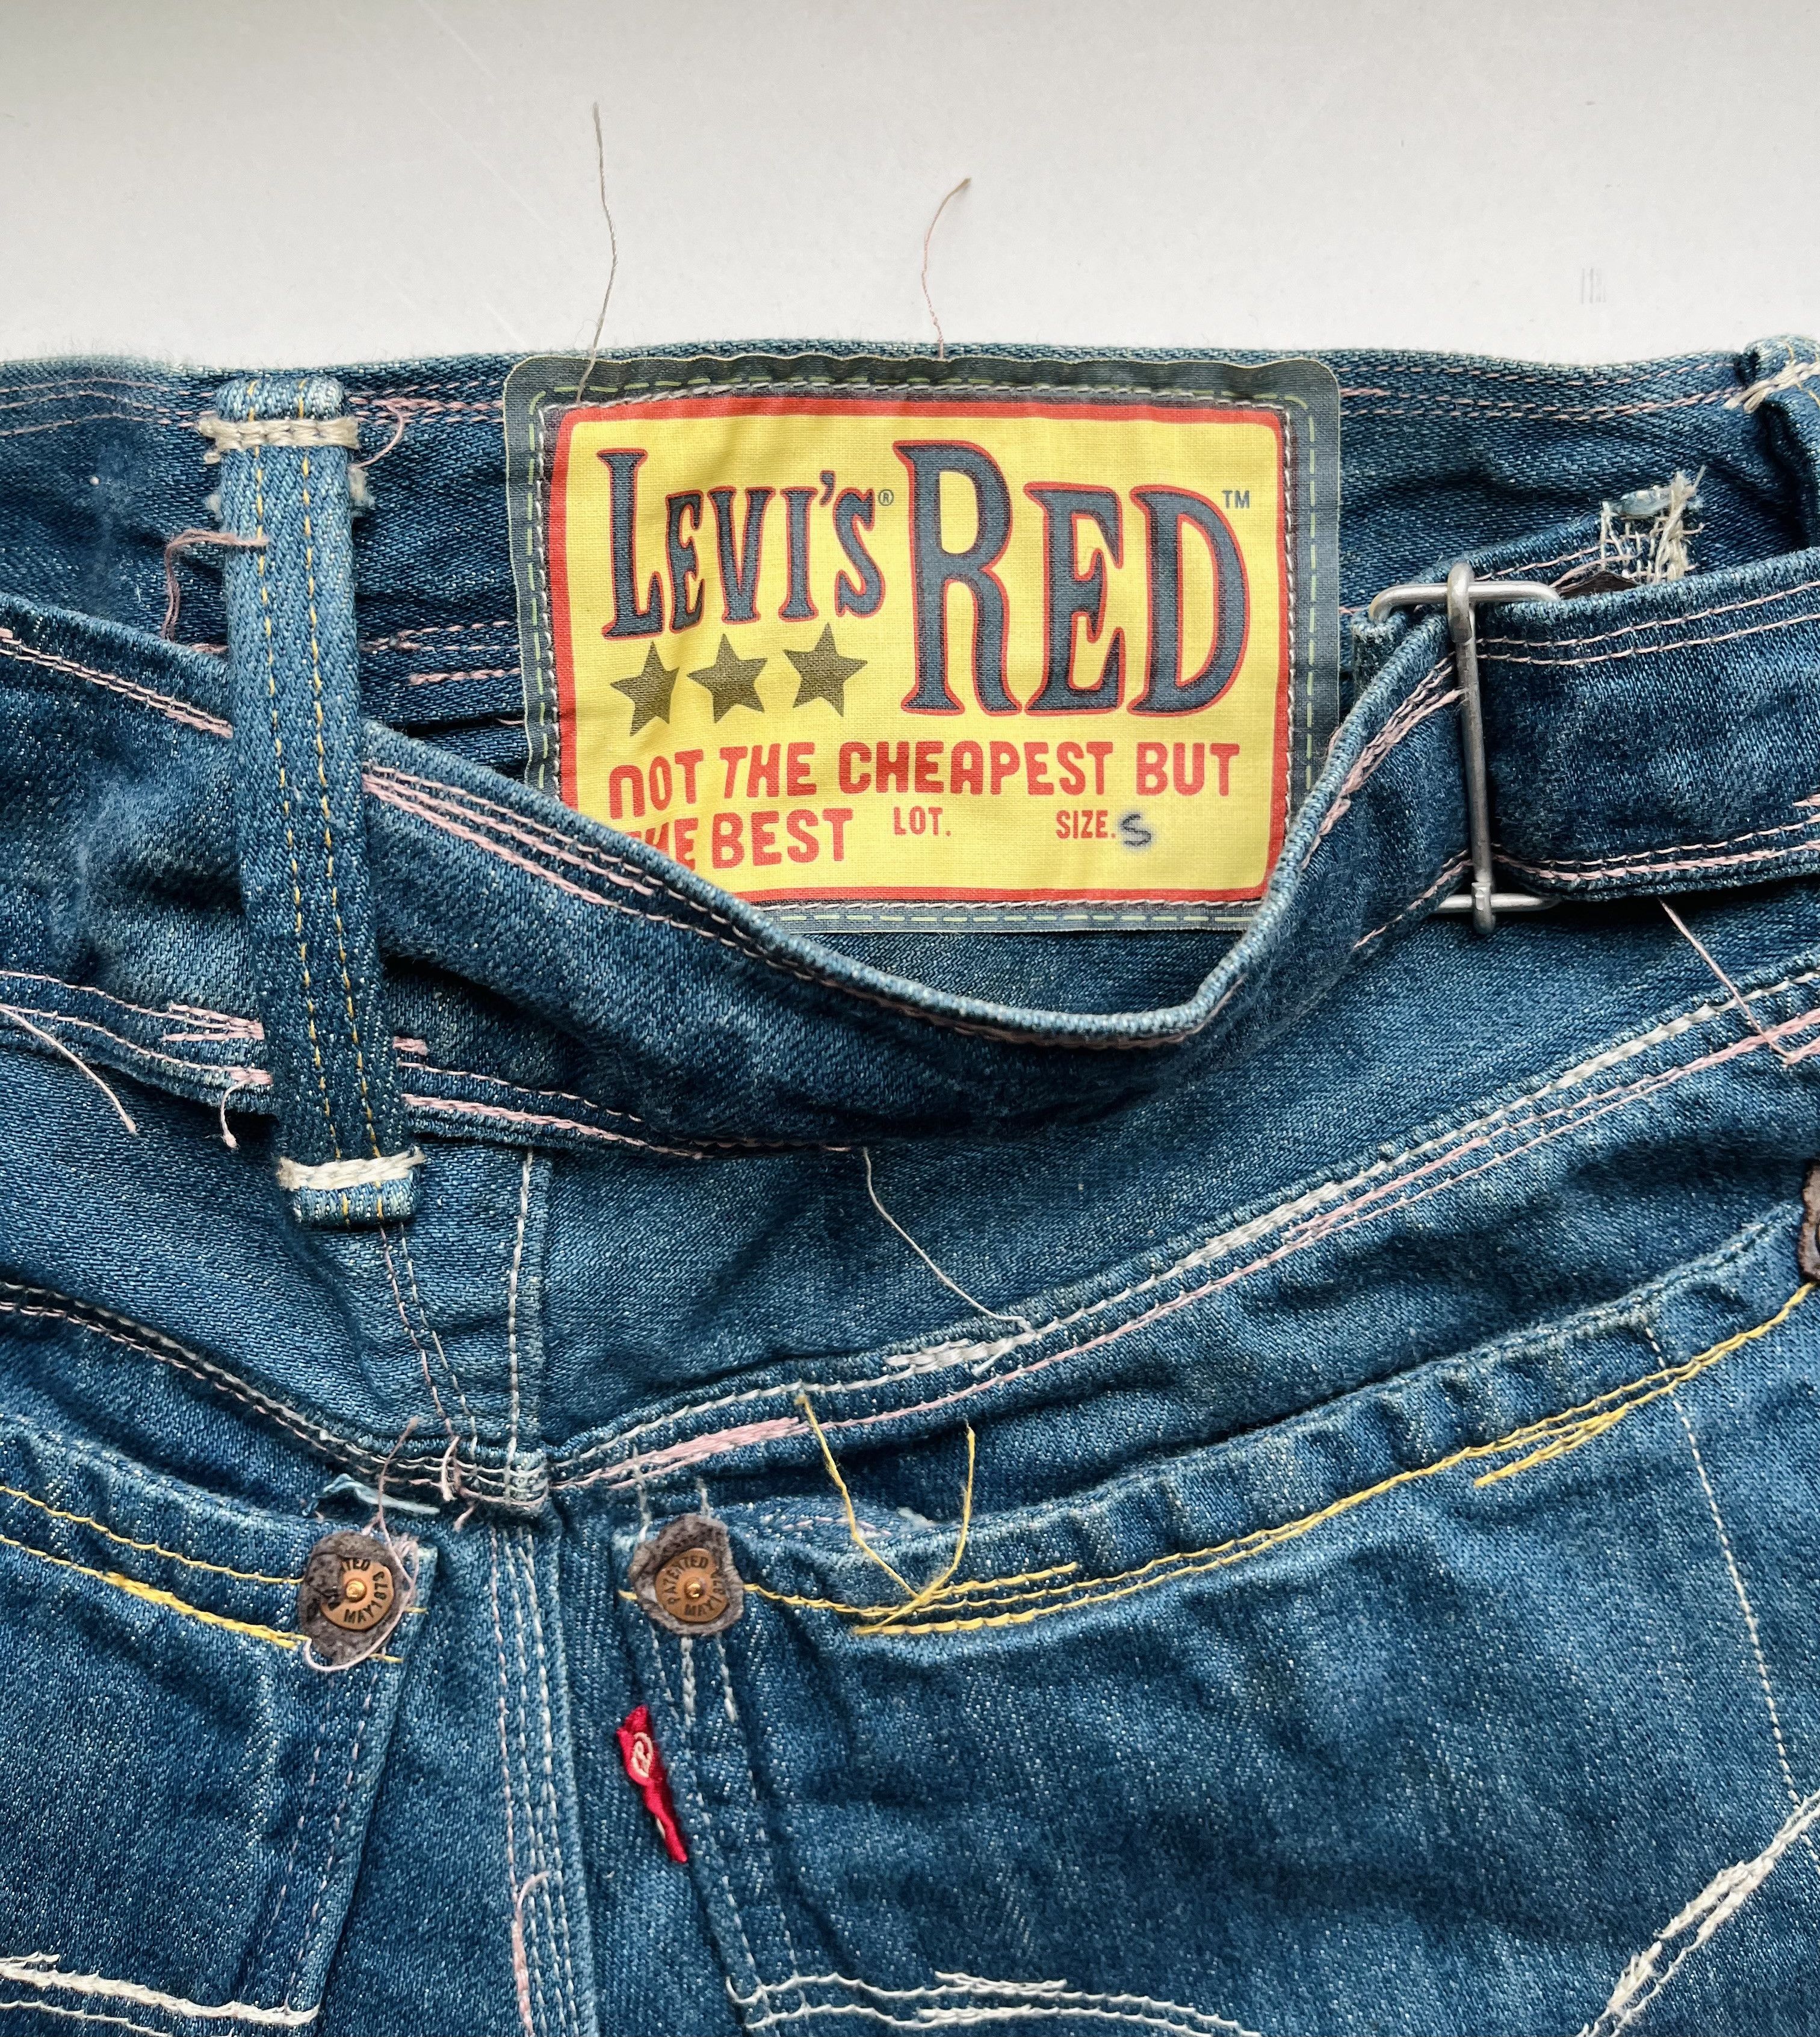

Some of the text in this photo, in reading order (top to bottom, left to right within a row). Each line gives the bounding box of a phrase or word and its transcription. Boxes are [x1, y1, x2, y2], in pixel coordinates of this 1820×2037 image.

[719, 741, 817, 799] THE
[838, 740, 1113, 796] CHEAPEST
[1136, 741, 1240, 796] BUT
[893, 806, 951, 837] LOT.
[1055, 809, 1117, 839] SIZE.
[712, 808, 853, 870] BEST
[345, 1604, 374, 1624] MAY
